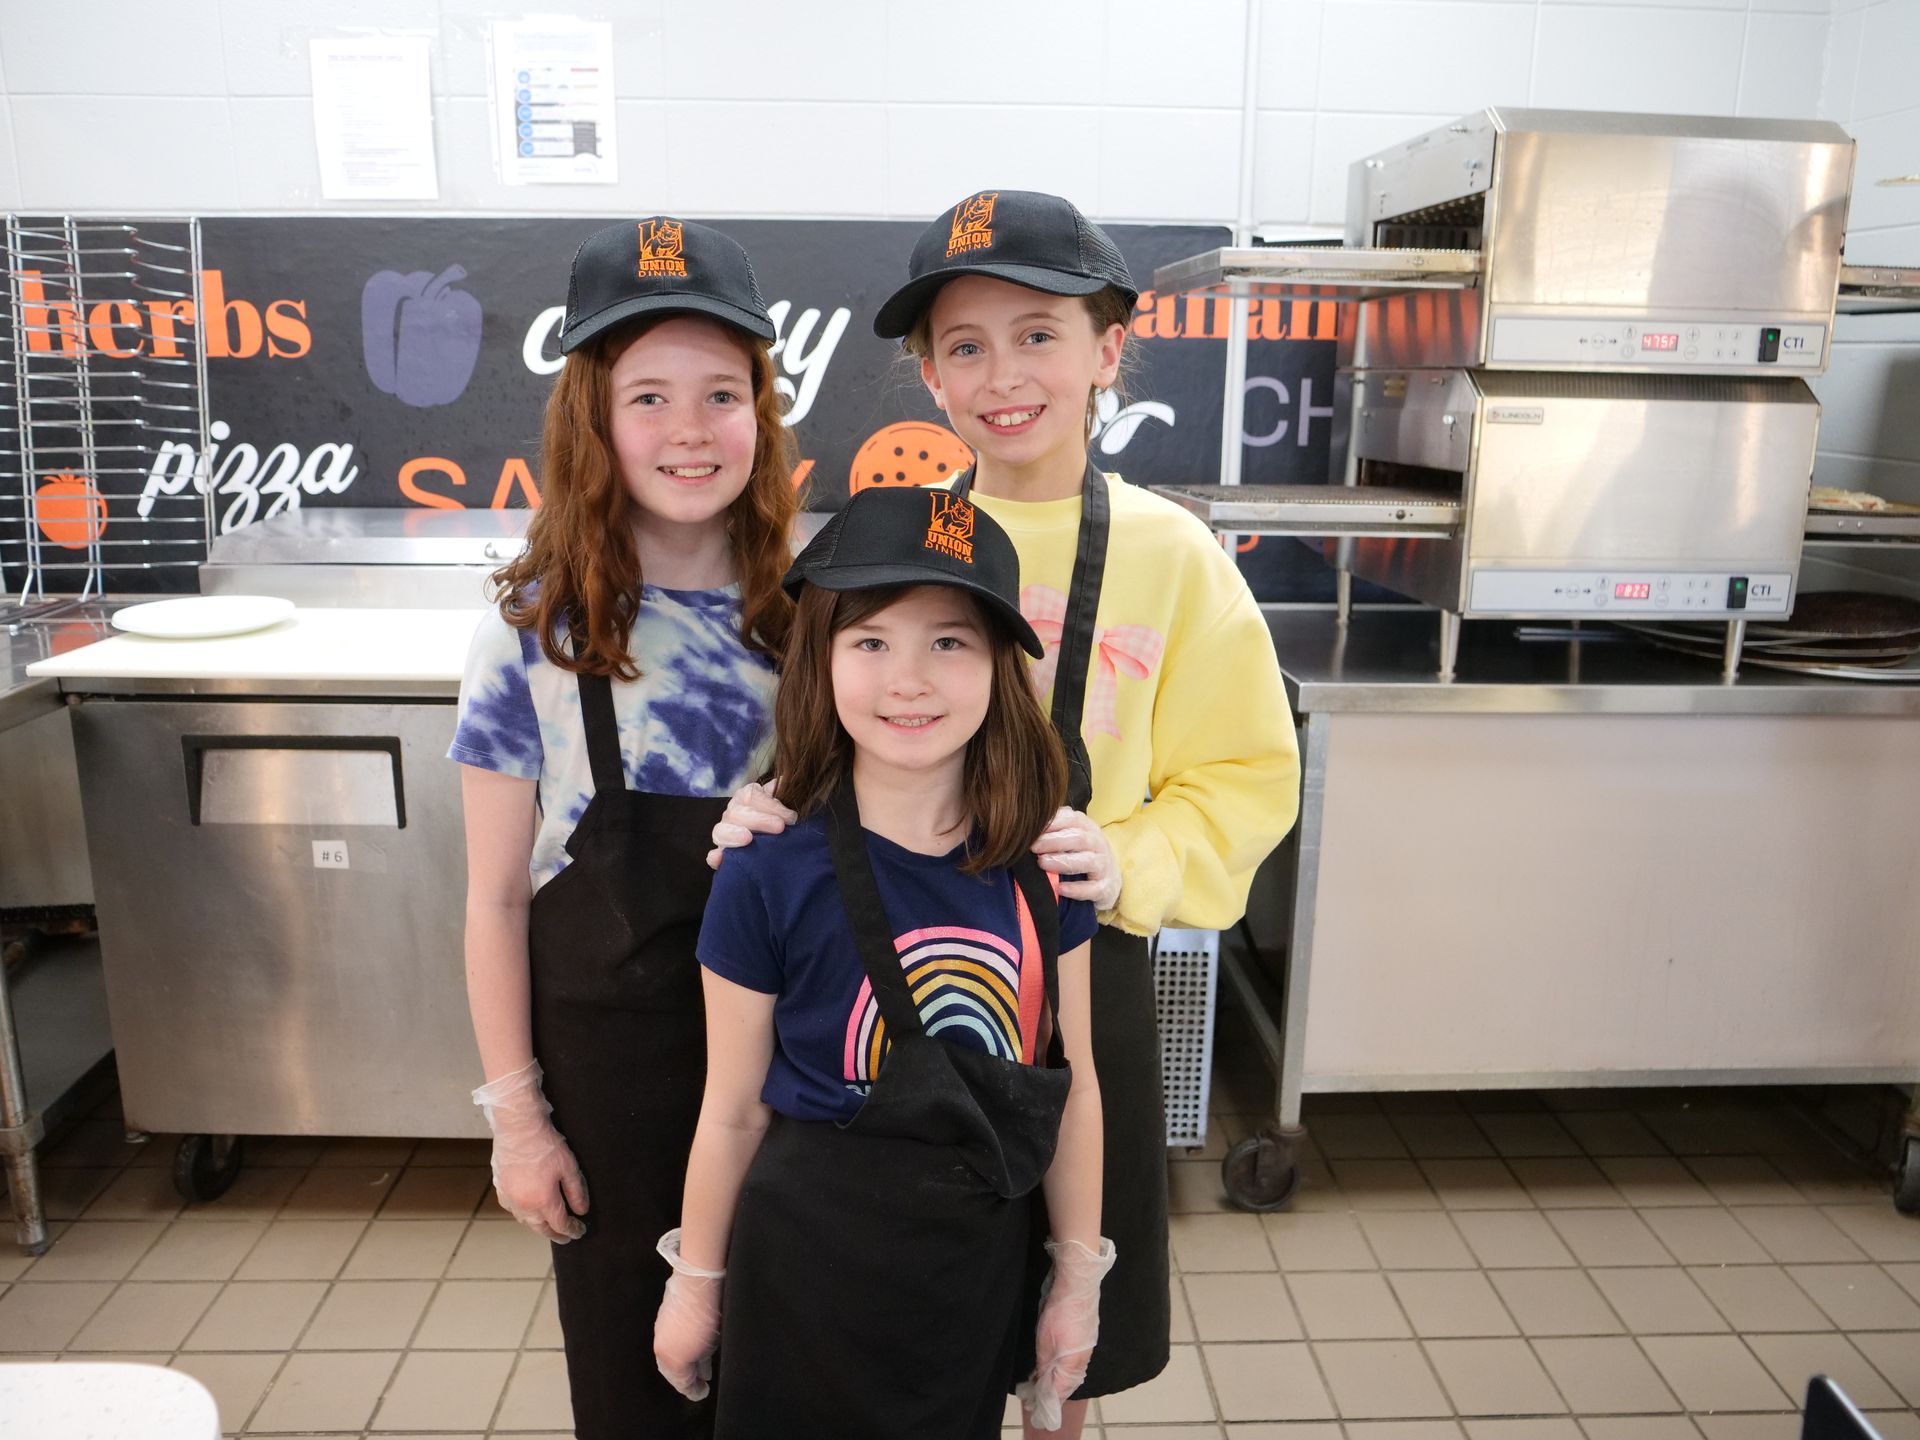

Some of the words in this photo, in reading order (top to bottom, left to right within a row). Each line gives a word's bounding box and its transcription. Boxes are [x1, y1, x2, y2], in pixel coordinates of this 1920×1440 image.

[948, 231, 993, 249] UNION
[946, 241, 993, 258] DINING
[638, 270, 688, 278] DINING
[639, 260, 685, 271] UNION
[15, 269, 312, 358] herbs
[1783, 336, 1804, 349] CTI
[137, 420, 359, 536] pizza
[924, 540, 973, 564] DINING
[927, 530, 973, 557] UNION
[1751, 584, 1771, 596] CTI
